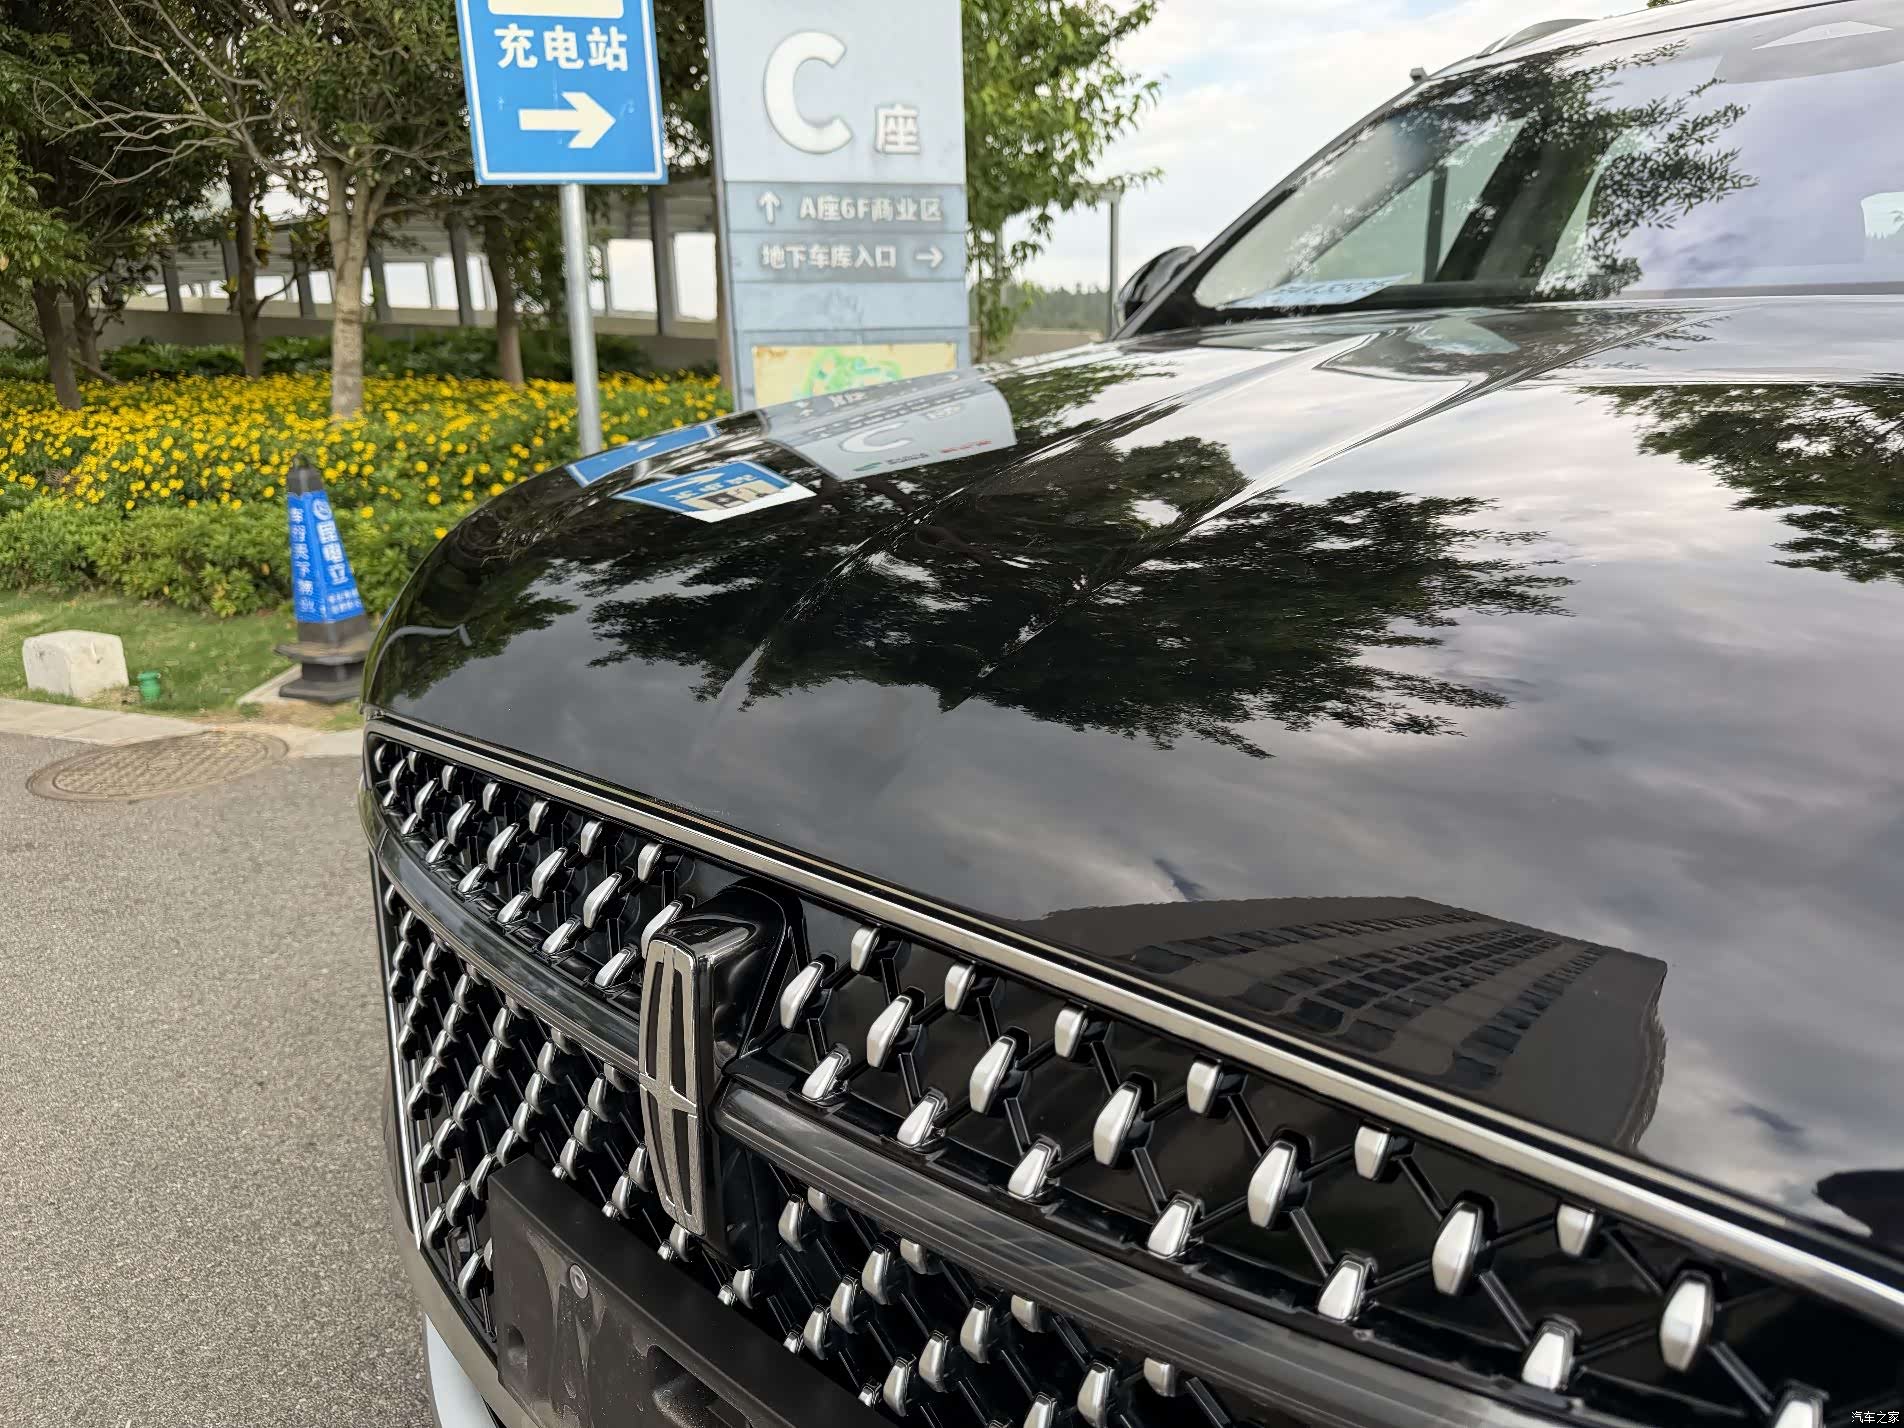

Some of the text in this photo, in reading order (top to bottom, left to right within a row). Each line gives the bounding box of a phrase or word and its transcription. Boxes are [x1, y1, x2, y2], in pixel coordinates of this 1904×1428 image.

[494, 23, 629, 72] 充电站
[763, 30, 922, 155] C座
[761, 243, 897, 270] 地下车库入口
